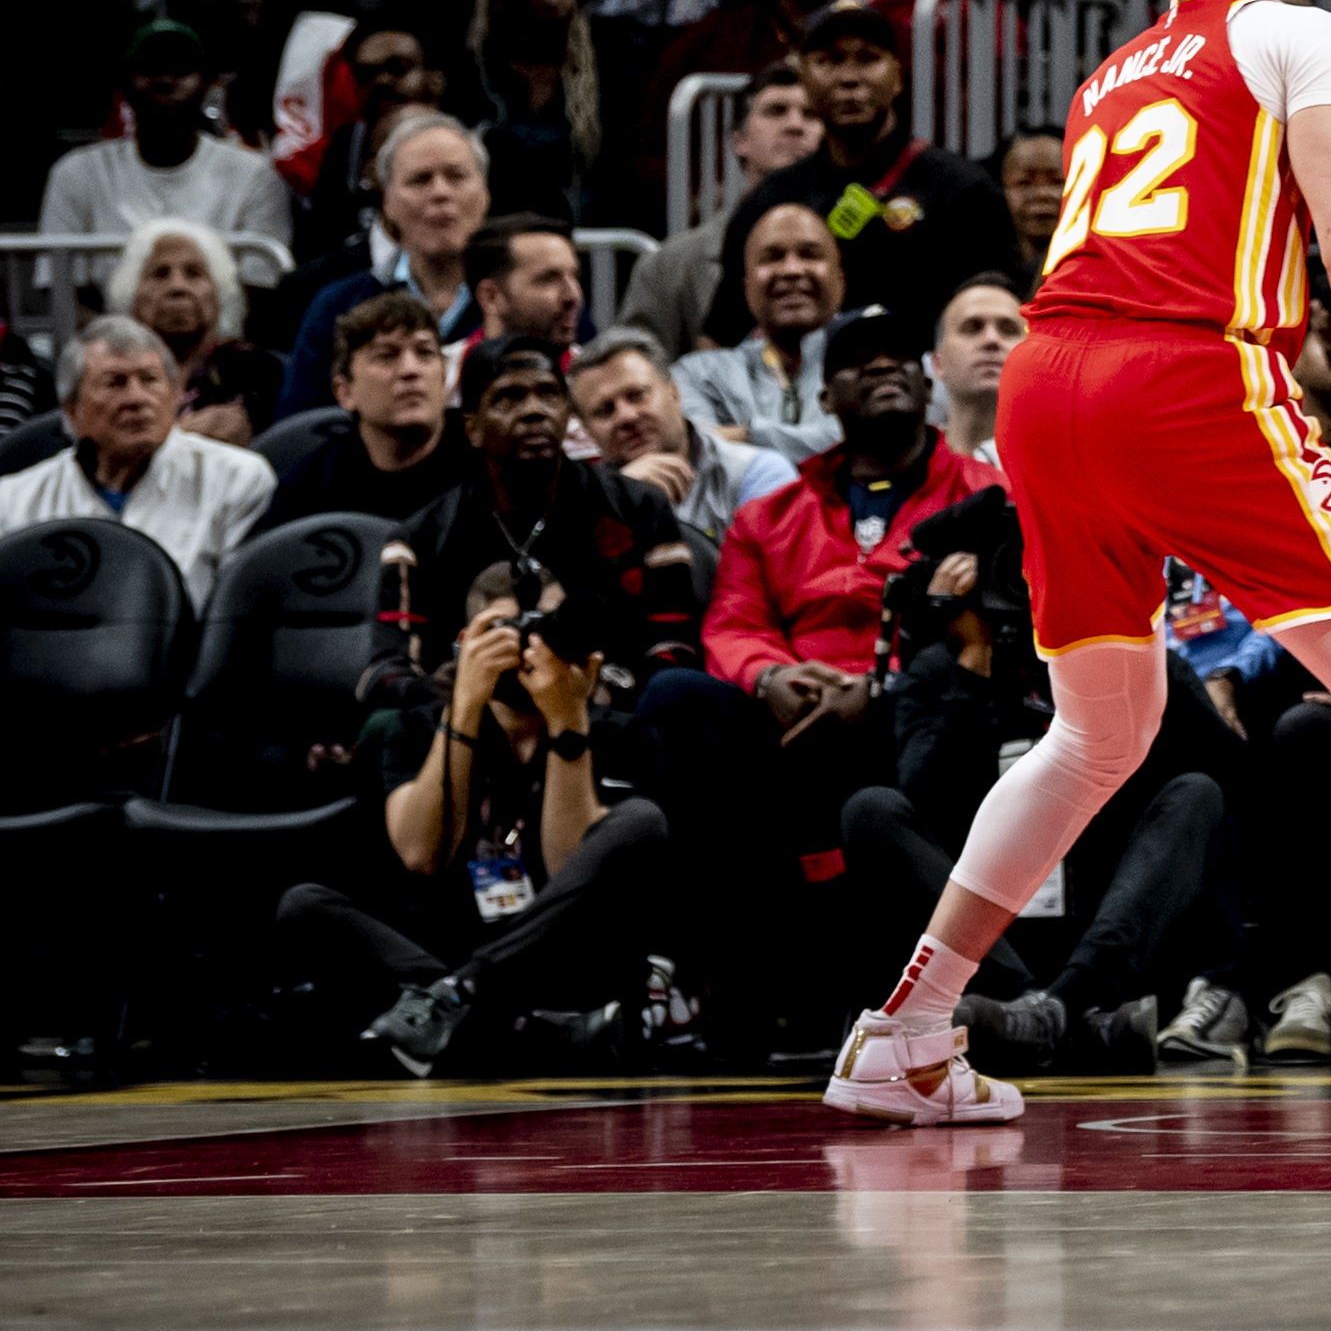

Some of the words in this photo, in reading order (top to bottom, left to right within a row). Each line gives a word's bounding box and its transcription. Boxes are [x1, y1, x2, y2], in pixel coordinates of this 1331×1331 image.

[1083, 36, 1171, 116] NANCE
[1160, 34, 1206, 79] JR.
[1042, 98, 1198, 276] 22
